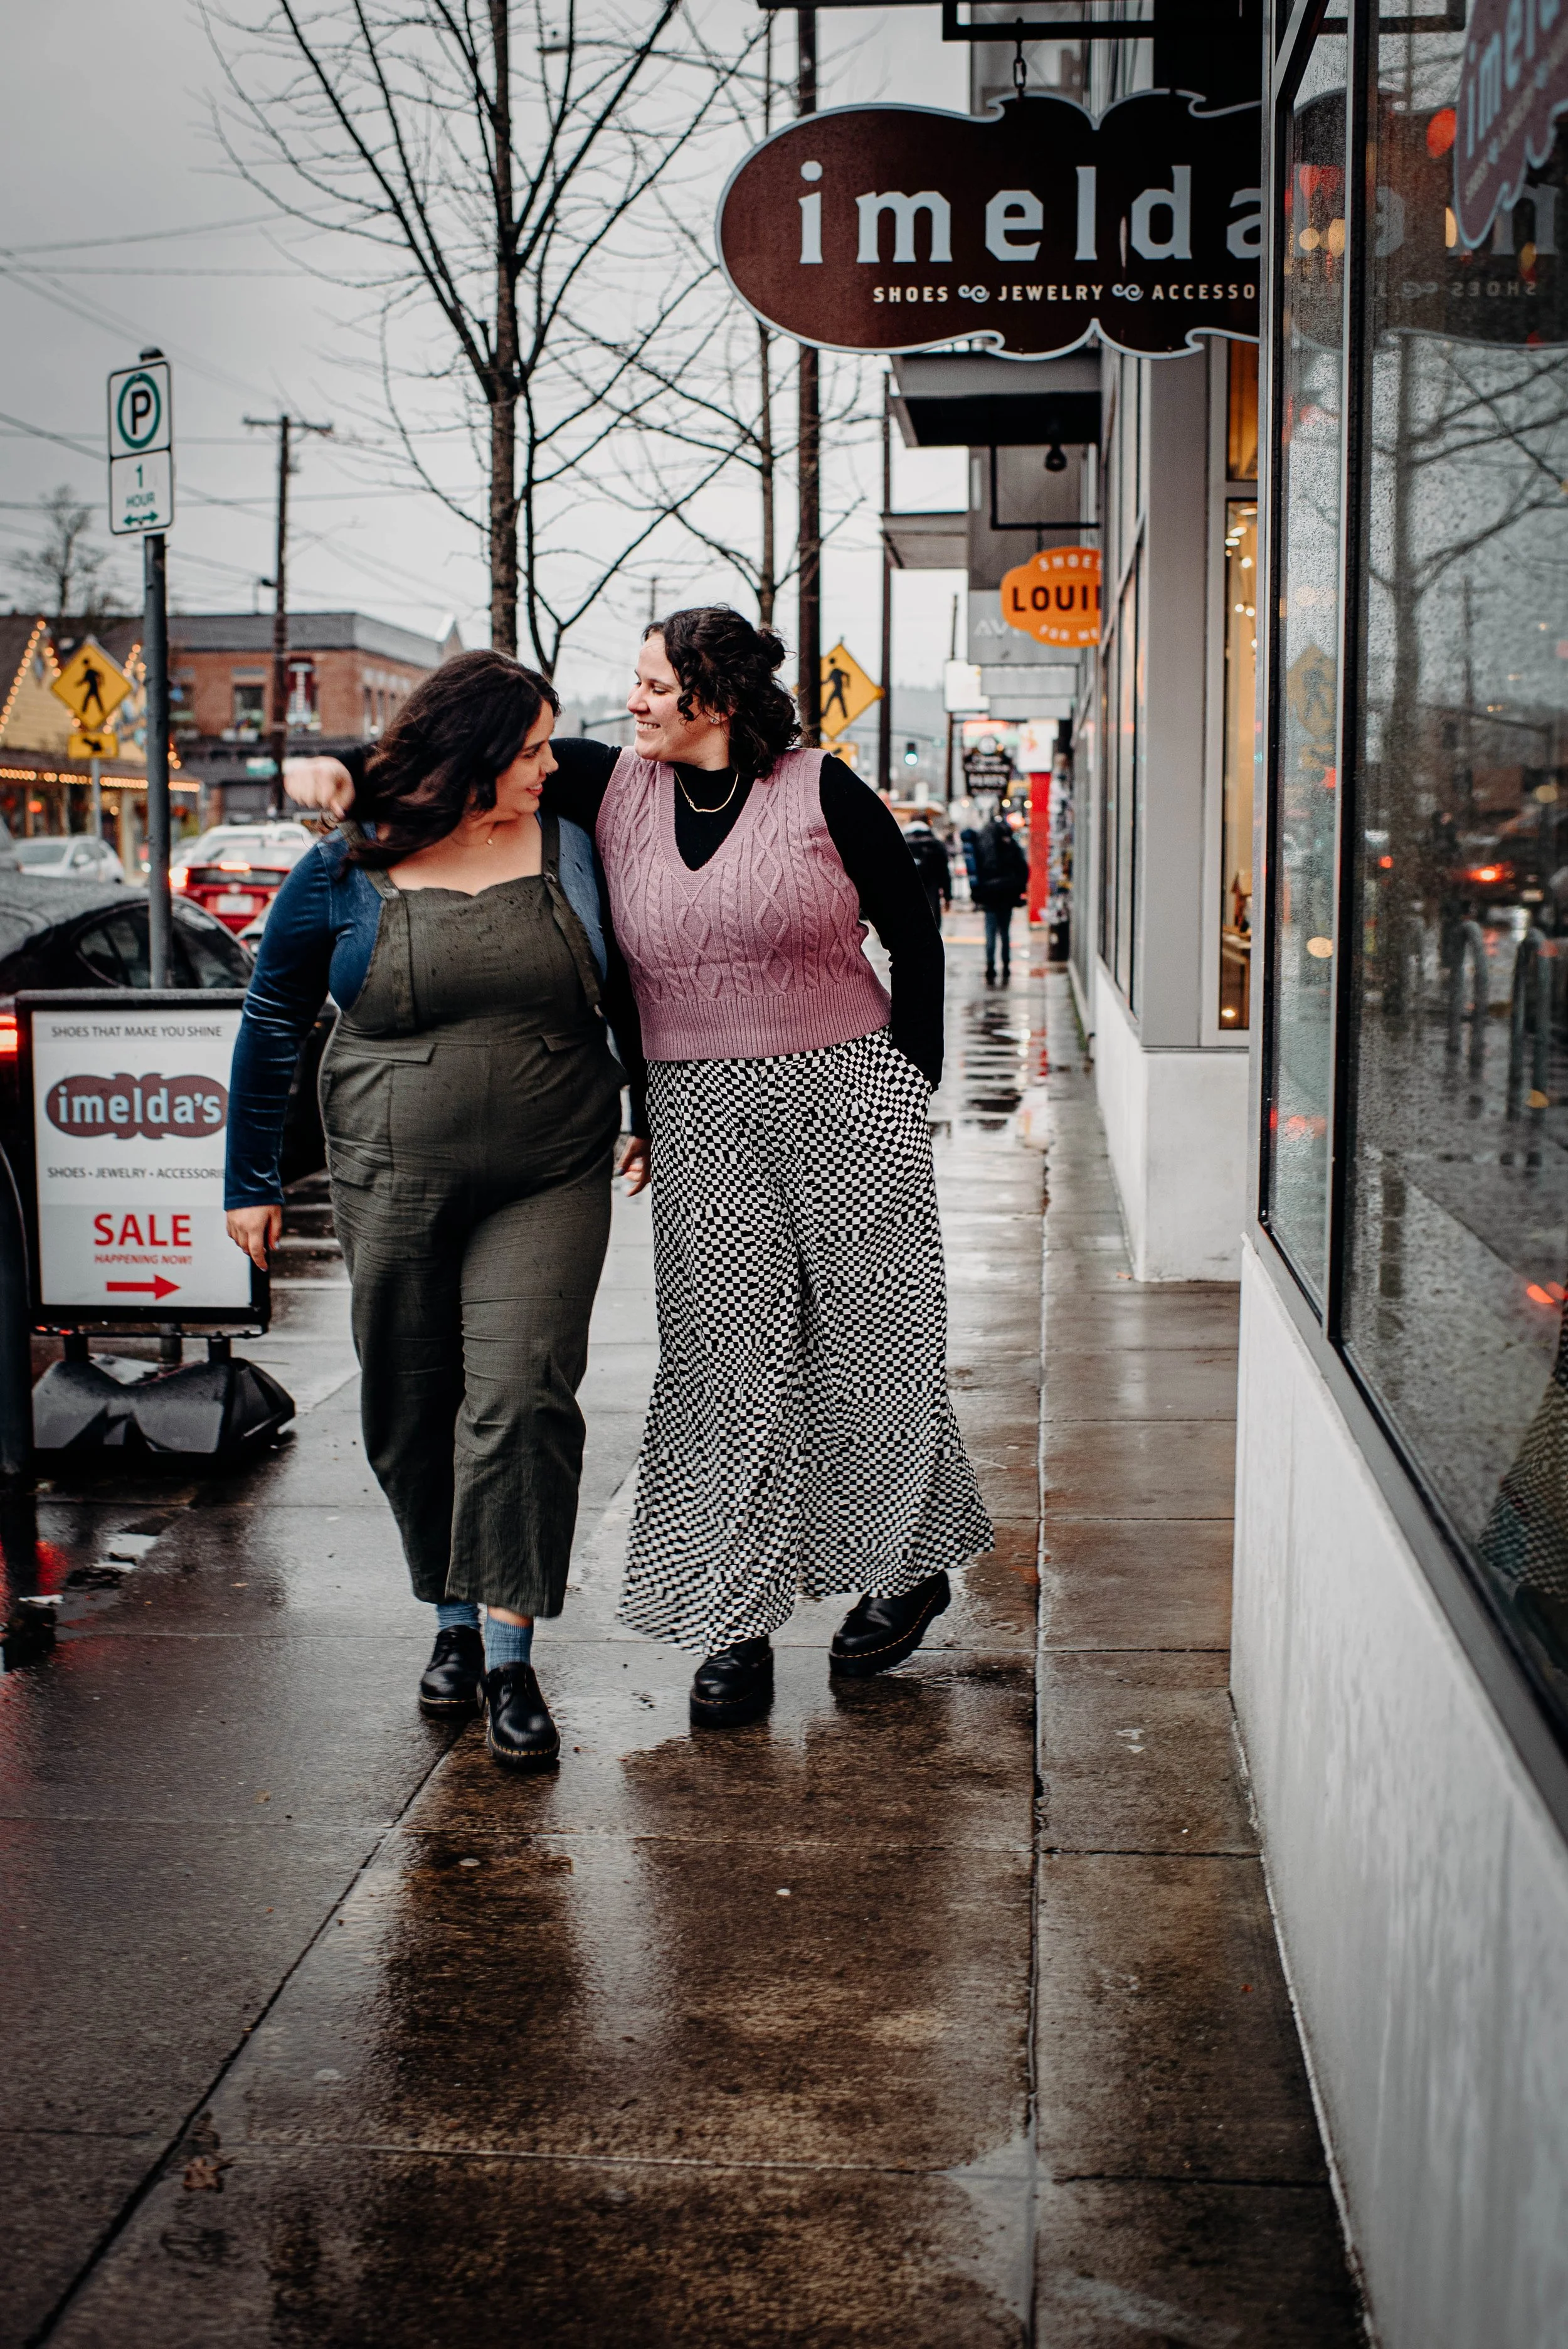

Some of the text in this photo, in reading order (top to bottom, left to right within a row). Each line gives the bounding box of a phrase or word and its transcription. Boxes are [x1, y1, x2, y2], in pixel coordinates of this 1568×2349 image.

[798, 159, 1261, 265] imelda
[873, 284, 1256, 303] SHOES JEWELRY ACCESSO
[130, 389, 152, 435] P
[135, 464, 144, 488] 1
[125, 492, 156, 509] HOUR
[51, 1026, 223, 1037] SHOES THAT MAKE YOU SHINE
[58, 1085, 222, 1124] imelda's
[47, 1167, 86, 1179] SHOES
[95, 1167, 147, 1179] JEWELRY
[93, 1213, 192, 1246] SALE
[95, 1254, 193, 1265] HAPPENING NOW!
